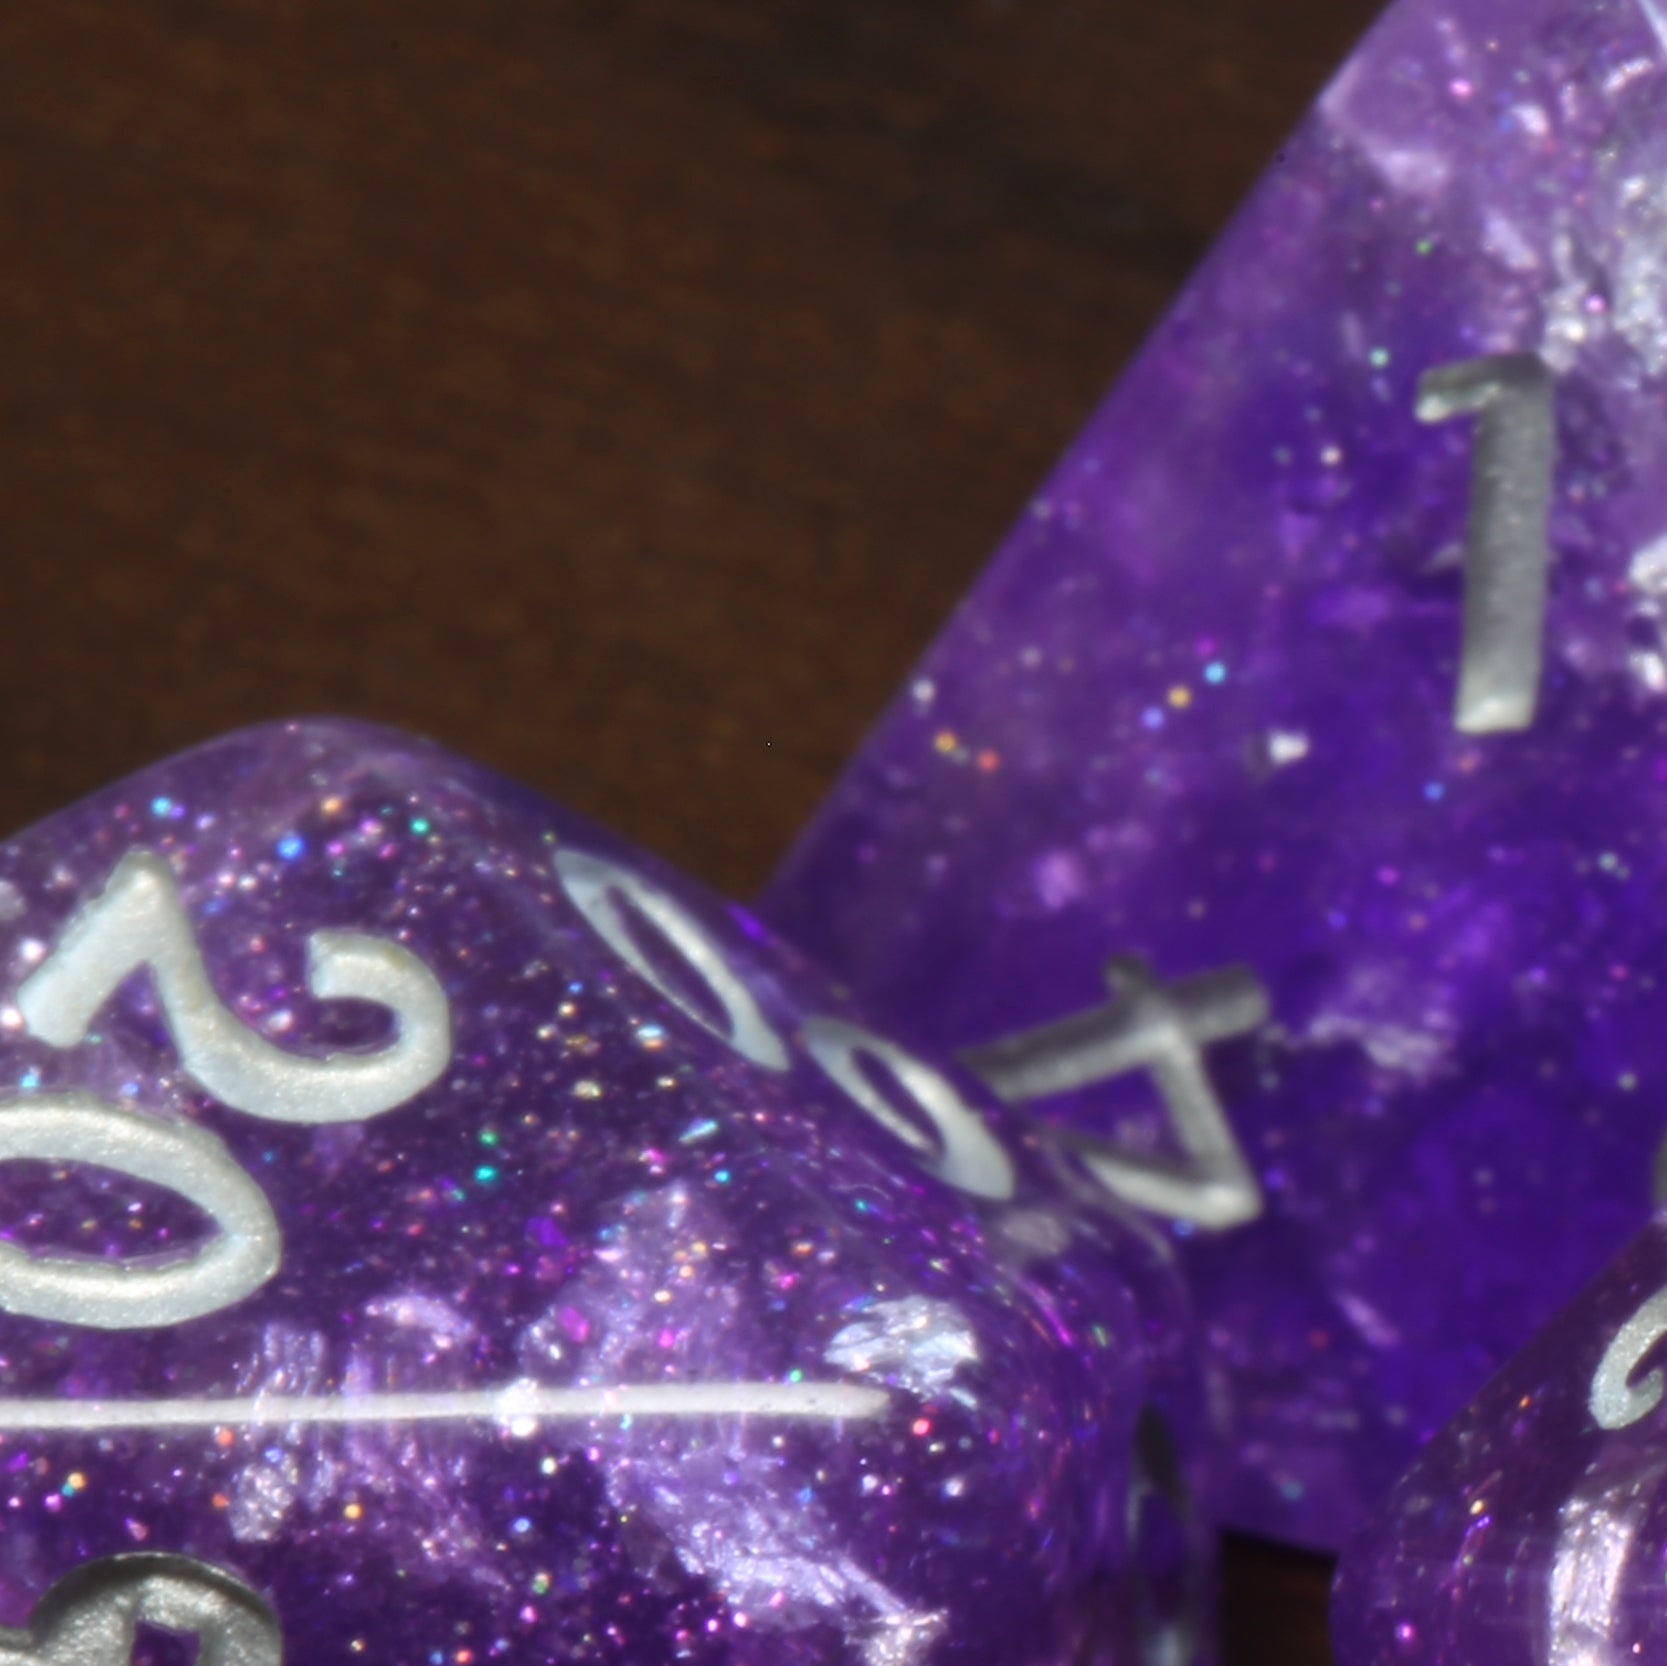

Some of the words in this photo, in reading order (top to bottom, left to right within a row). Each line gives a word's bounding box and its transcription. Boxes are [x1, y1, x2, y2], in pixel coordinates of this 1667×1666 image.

[1415, 350, 1556, 733] 1
[0, 845, 452, 1330] 20
[948, 953, 1270, 1232] 4
